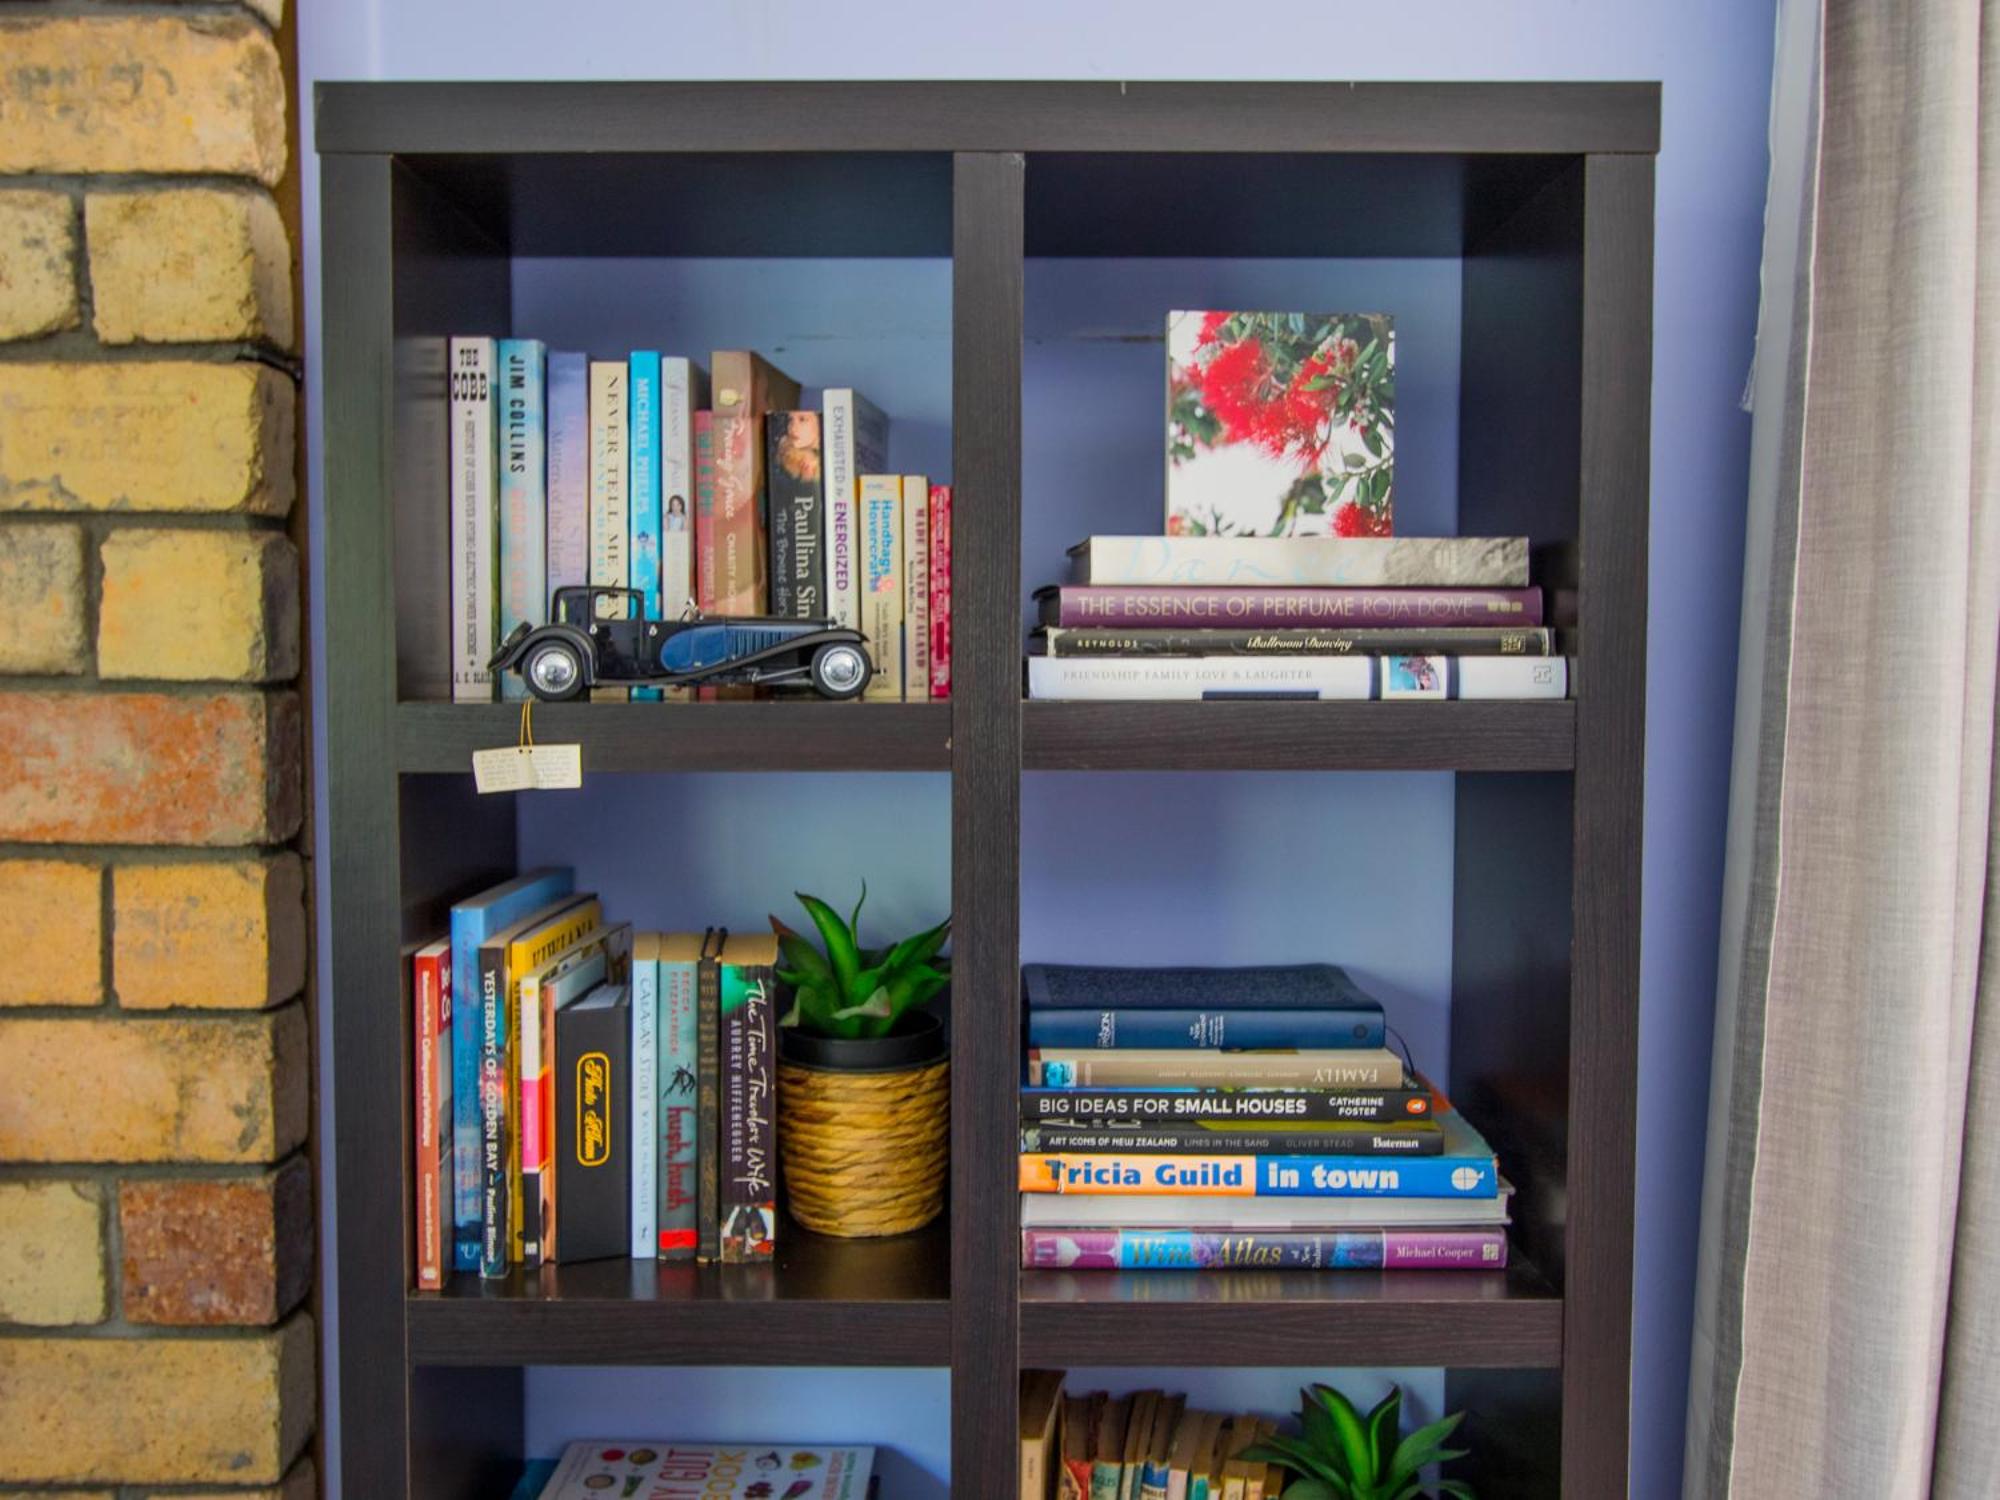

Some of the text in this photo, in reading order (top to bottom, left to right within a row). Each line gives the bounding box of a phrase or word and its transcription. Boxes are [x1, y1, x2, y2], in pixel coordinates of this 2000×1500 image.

[453, 372, 488, 401] COBB
[509, 355, 526, 474] JIM COLLINS
[607, 375, 619, 455] NEVER
[637, 378, 650, 449] MICHAEL
[833, 406, 846, 483] EXHAUSTED
[607, 467, 619, 522] TELL
[776, 509, 788, 534] The
[794, 496, 817, 579] Paullina
[879, 500, 894, 577] Handbags
[607, 533, 619, 567] ME
[834, 502, 849, 591] ENERGIZED
[915, 508, 926, 668] MADE IN NEW ZEALAND
[1077, 596, 1116, 617] THE
[1124, 596, 1219, 617] ESSENCE
[1226, 596, 1258, 617] OF
[1263, 597, 1354, 617] PERFUME
[1363, 597, 1409, 620] ROJA
[1417, 597, 1473, 618] DOVE
[1077, 634, 1353, 652] REYNOLDS Ballroom Dancing
[1063, 669, 1140, 681] FRIENDSHIP
[1145, 669, 1190, 681] FAMILY
[1195, 669, 1228, 681] LOVE
[1245, 669, 1313, 681] LAUGHTER
[484, 970, 497, 1056] YESTERDAYS
[639, 977, 652, 1050] CARAVAN
[744, 978, 767, 1023] The
[746, 1015, 767, 1073] Time
[486, 1058, 498, 1078] OF
[639, 1057, 652, 1100] STORY
[1312, 1068, 1378, 1083] FAMILY
[485, 1081, 498, 1139] GOLDEN
[730, 1020, 742, 1163] AUDREY NIFFENEGGER
[1039, 1099, 1307, 1114] BIG IDEAS FOR SMALL HOUSES
[1328, 1097, 1385, 1106] CATHERINE
[1338, 1107, 1377, 1116] FOSTER
[486, 1142, 498, 1171] BAY
[1049, 1136, 1419, 1149] ART ICONS OF NEW ZEALAND LINES IN THE SAND OLIVER STEAD Bateman
[734, 1148, 770, 1196] Wife
[1045, 1159, 1399, 1189] Tricia Guild in town
[1217, 1236, 1282, 1265] Atlas
[1395, 1244, 1475, 1260] Michael Cooper
